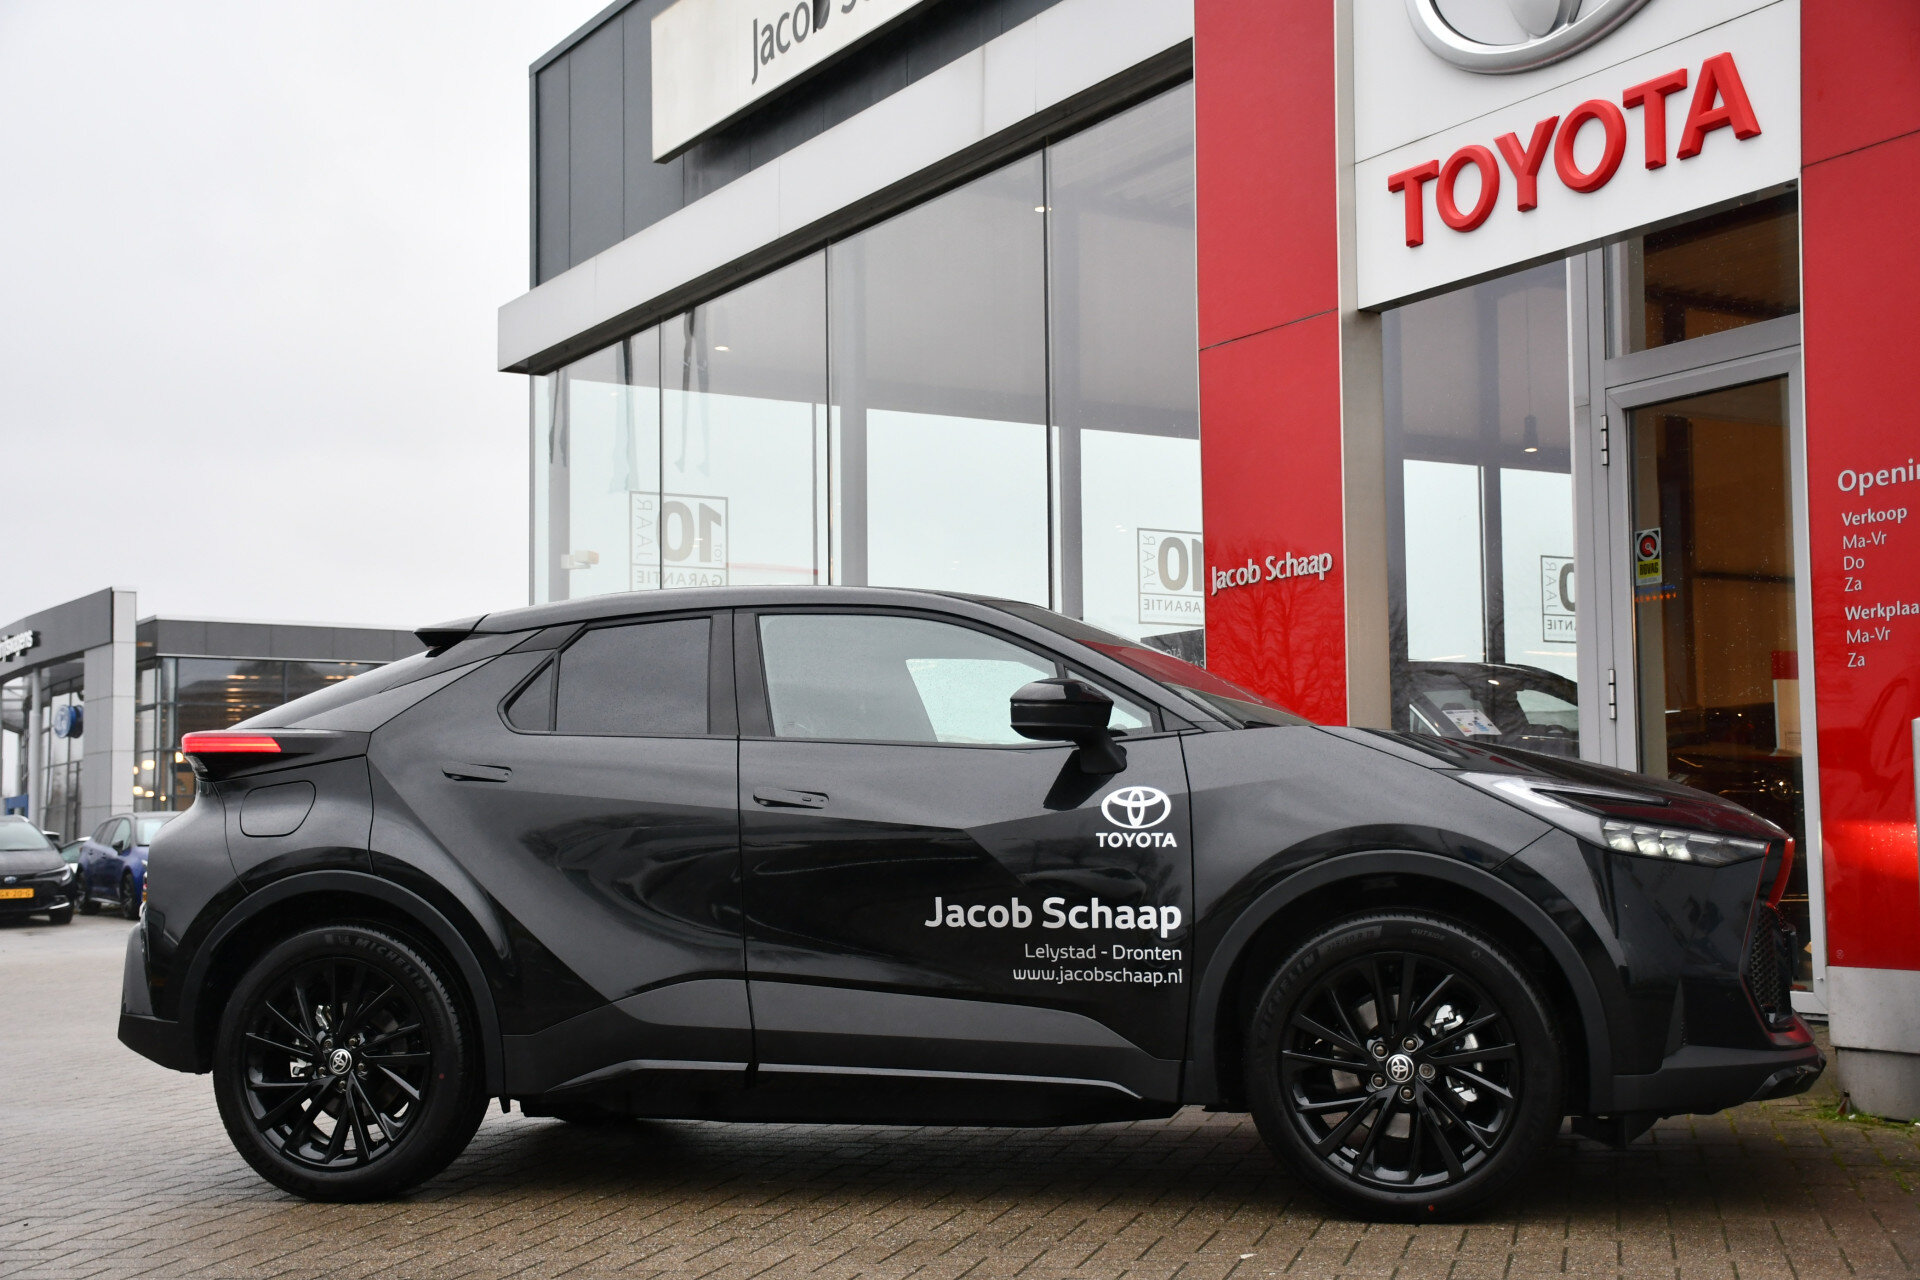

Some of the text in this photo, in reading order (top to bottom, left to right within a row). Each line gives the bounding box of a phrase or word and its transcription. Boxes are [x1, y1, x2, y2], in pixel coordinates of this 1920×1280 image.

[1387, 52, 1762, 248] TOYOTA
[1838, 458, 1920, 496] Openi
[1841, 507, 1908, 527] Verkoop
[1842, 530, 1887, 550] Ma-Vr
[1843, 555, 1865, 571] Do
[1211, 552, 1333, 596] Jacob Schaap
[1844, 576, 1862, 592] Za
[1846, 626, 1891, 644] Ma-Vr
[1847, 652, 1866, 668] Za
[1095, 832, 1178, 848] TOYOTA
[924, 896, 1182, 938] Jacob Schaap
[1024, 943, 1097, 962] Lelystad
[1112, 944, 1182, 961] Dronten
[1013, 966, 1183, 987] www.jacobschaap.nl
